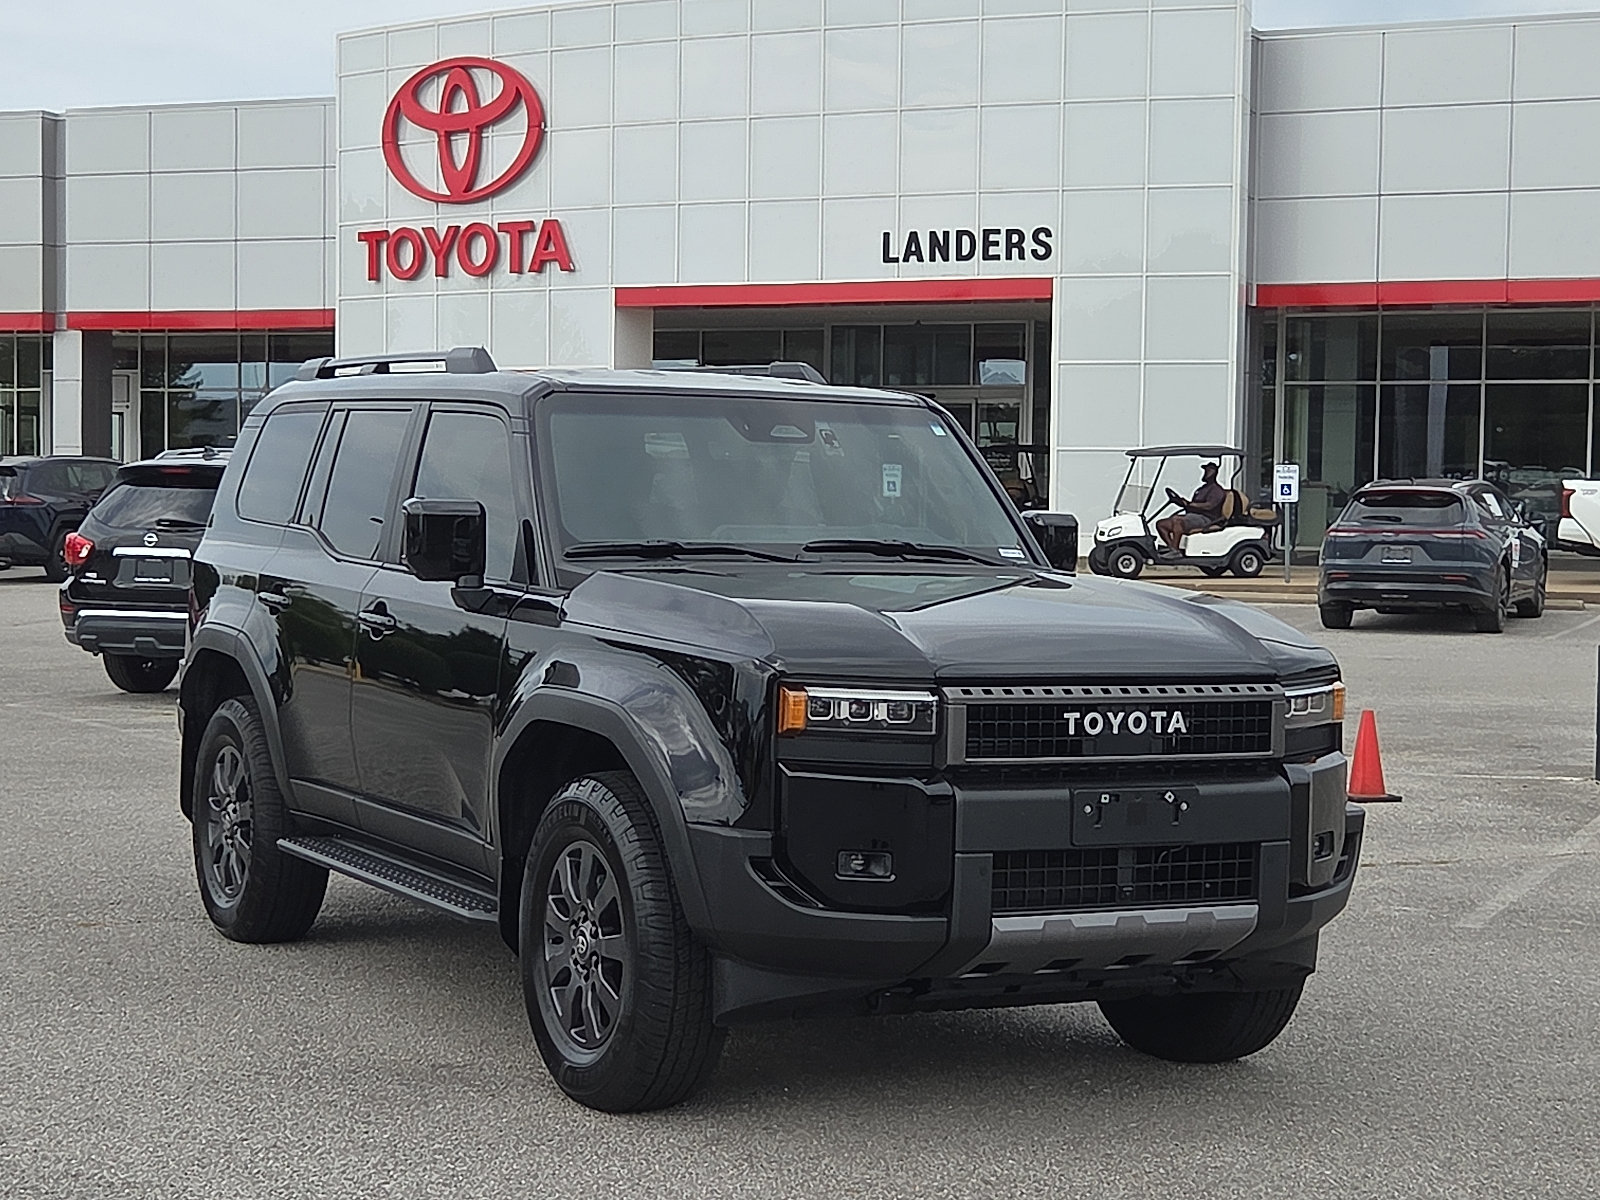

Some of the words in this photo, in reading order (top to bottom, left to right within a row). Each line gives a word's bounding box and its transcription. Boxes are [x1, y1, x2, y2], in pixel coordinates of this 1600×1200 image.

[358, 219, 575, 281] TOYOTA
[882, 227, 1053, 263] LANDERS
[1063, 711, 1187, 735] TOYOTA
